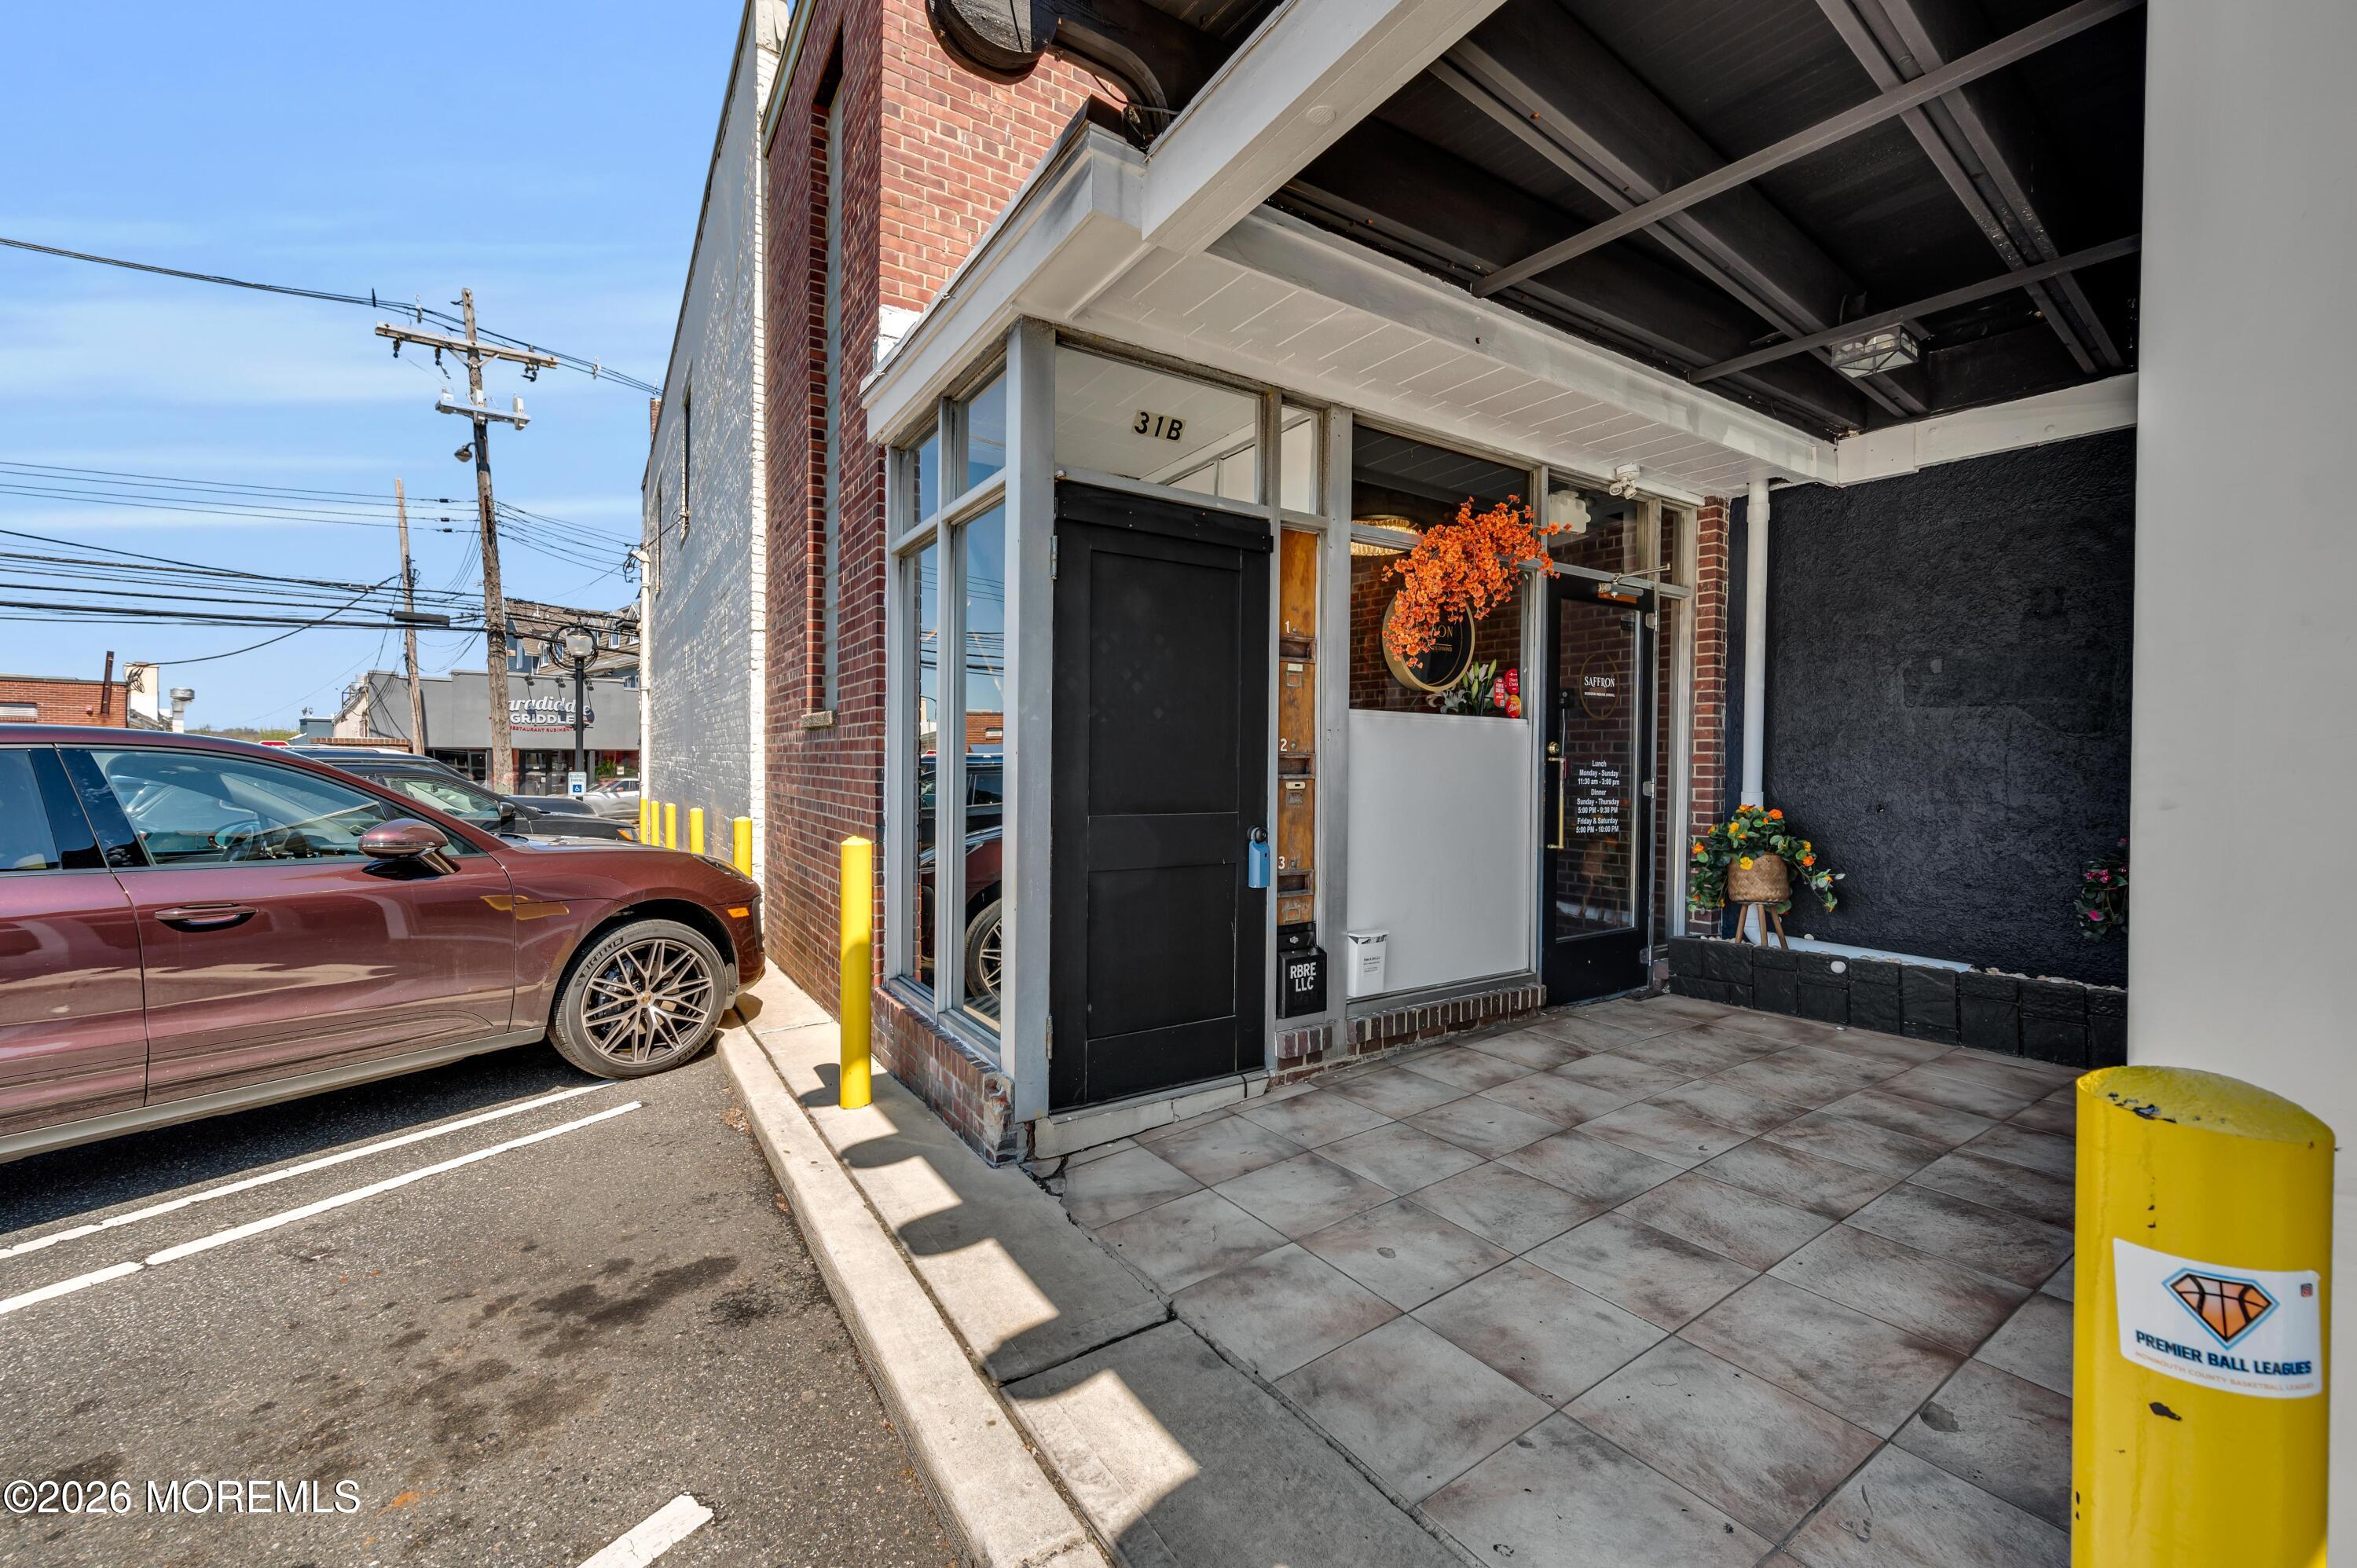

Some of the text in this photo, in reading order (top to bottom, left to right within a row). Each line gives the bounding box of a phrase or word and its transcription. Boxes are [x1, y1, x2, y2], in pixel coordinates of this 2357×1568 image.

[1134, 412, 1183, 441] 31B
[1285, 621, 1291, 632] 1
[1584, 676, 1615, 687] SAFFRON
[508, 695, 591, 716] aradidde
[509, 713, 575, 724] GRIDDLE
[1280, 738, 1288, 752] 2
[1601, 769, 1619, 779] Sunday
[1278, 856, 1285, 869] 3
[581, 936, 624, 978] MICHELIN
[1290, 962, 1317, 979] RBRE
[1295, 976, 1314, 992] LLC
[2135, 1329, 2312, 1376] PREMIER BALL LEAGUES
[2135, 1351, 2186, 1373] MONMOUTH
[2188, 1368, 2227, 1383] COUNTY
[2230, 1376, 2284, 1391] BASKETBALL
